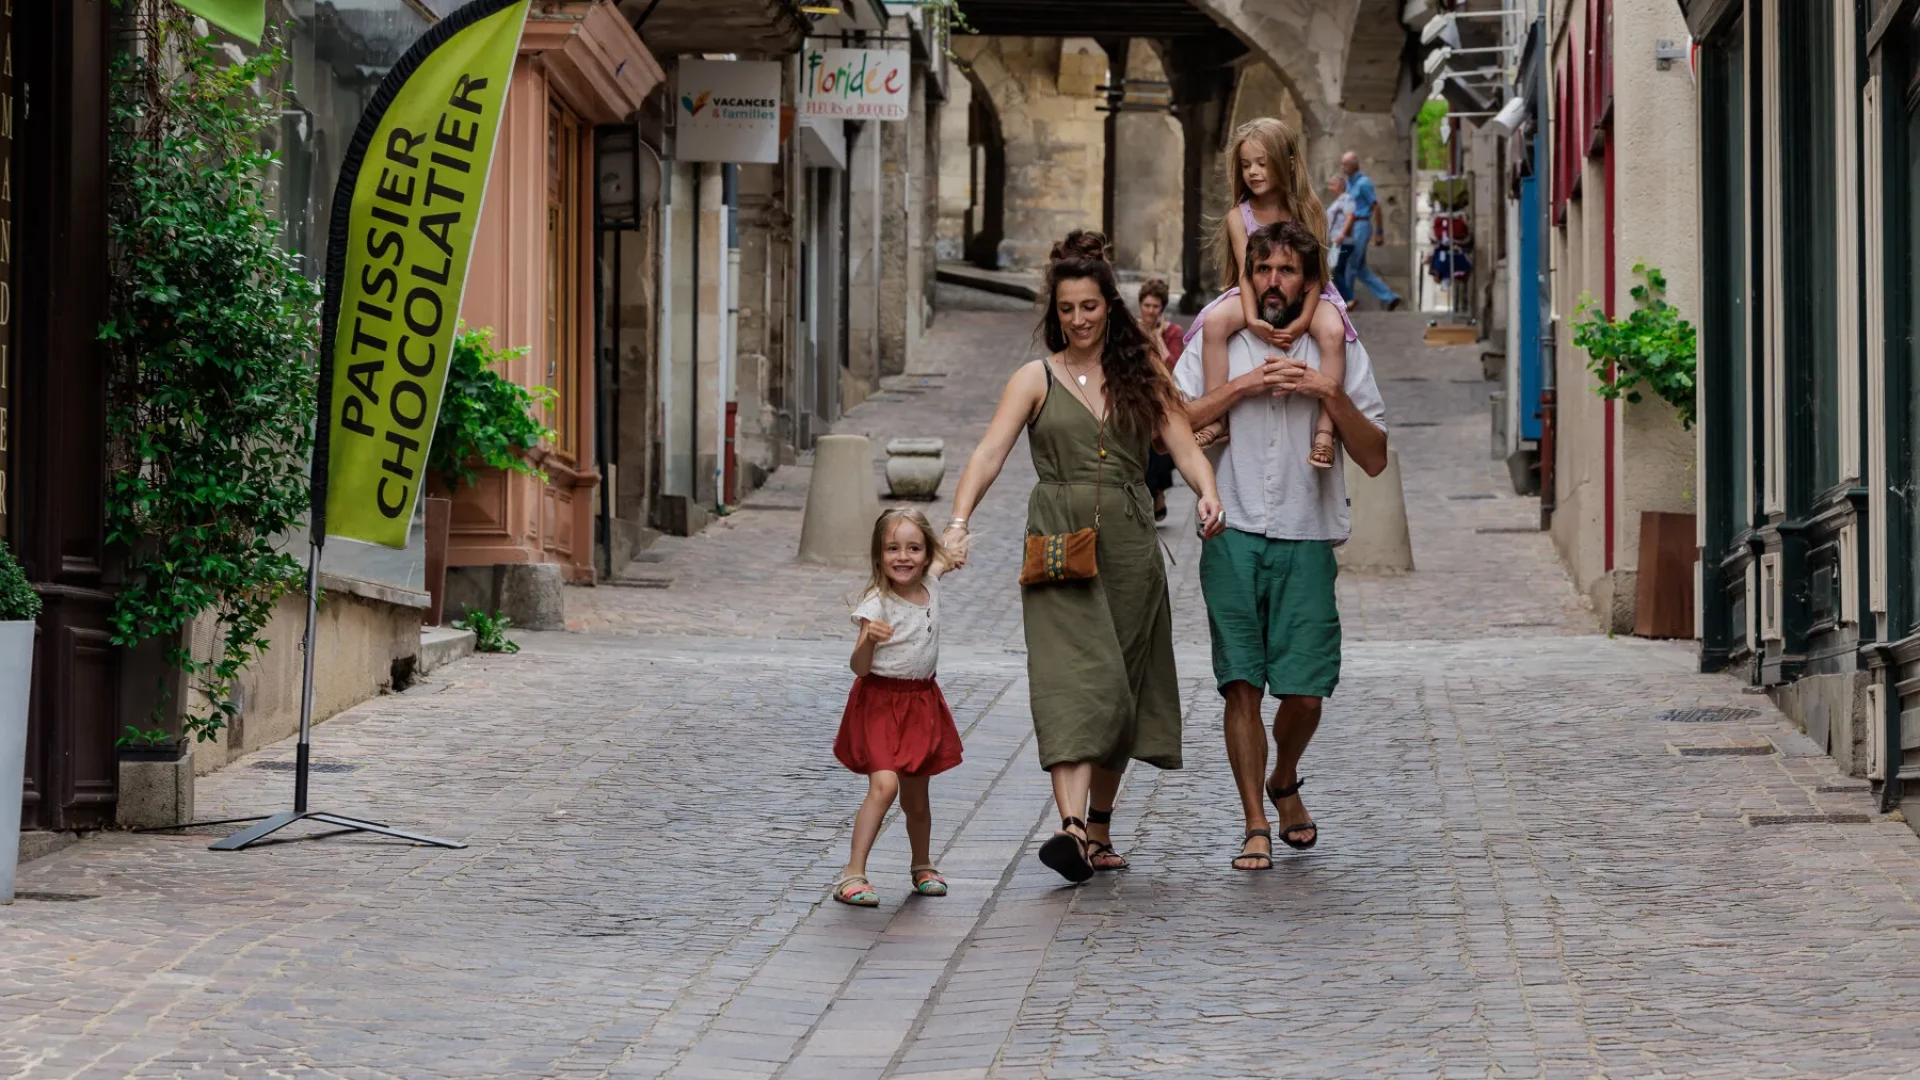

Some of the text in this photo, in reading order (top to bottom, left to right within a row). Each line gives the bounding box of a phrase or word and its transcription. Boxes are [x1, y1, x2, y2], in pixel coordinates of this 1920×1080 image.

[808, 51, 903, 100] Floridée
[712, 108, 775, 120] & familles
[713, 98, 775, 107] VACANCES
[806, 102, 844, 114] FLEURS
[857, 103, 905, 117] BOUQUETS
[341, 127, 427, 437] PATISSIER
[377, 72, 489, 518] CHOCOLATIER
